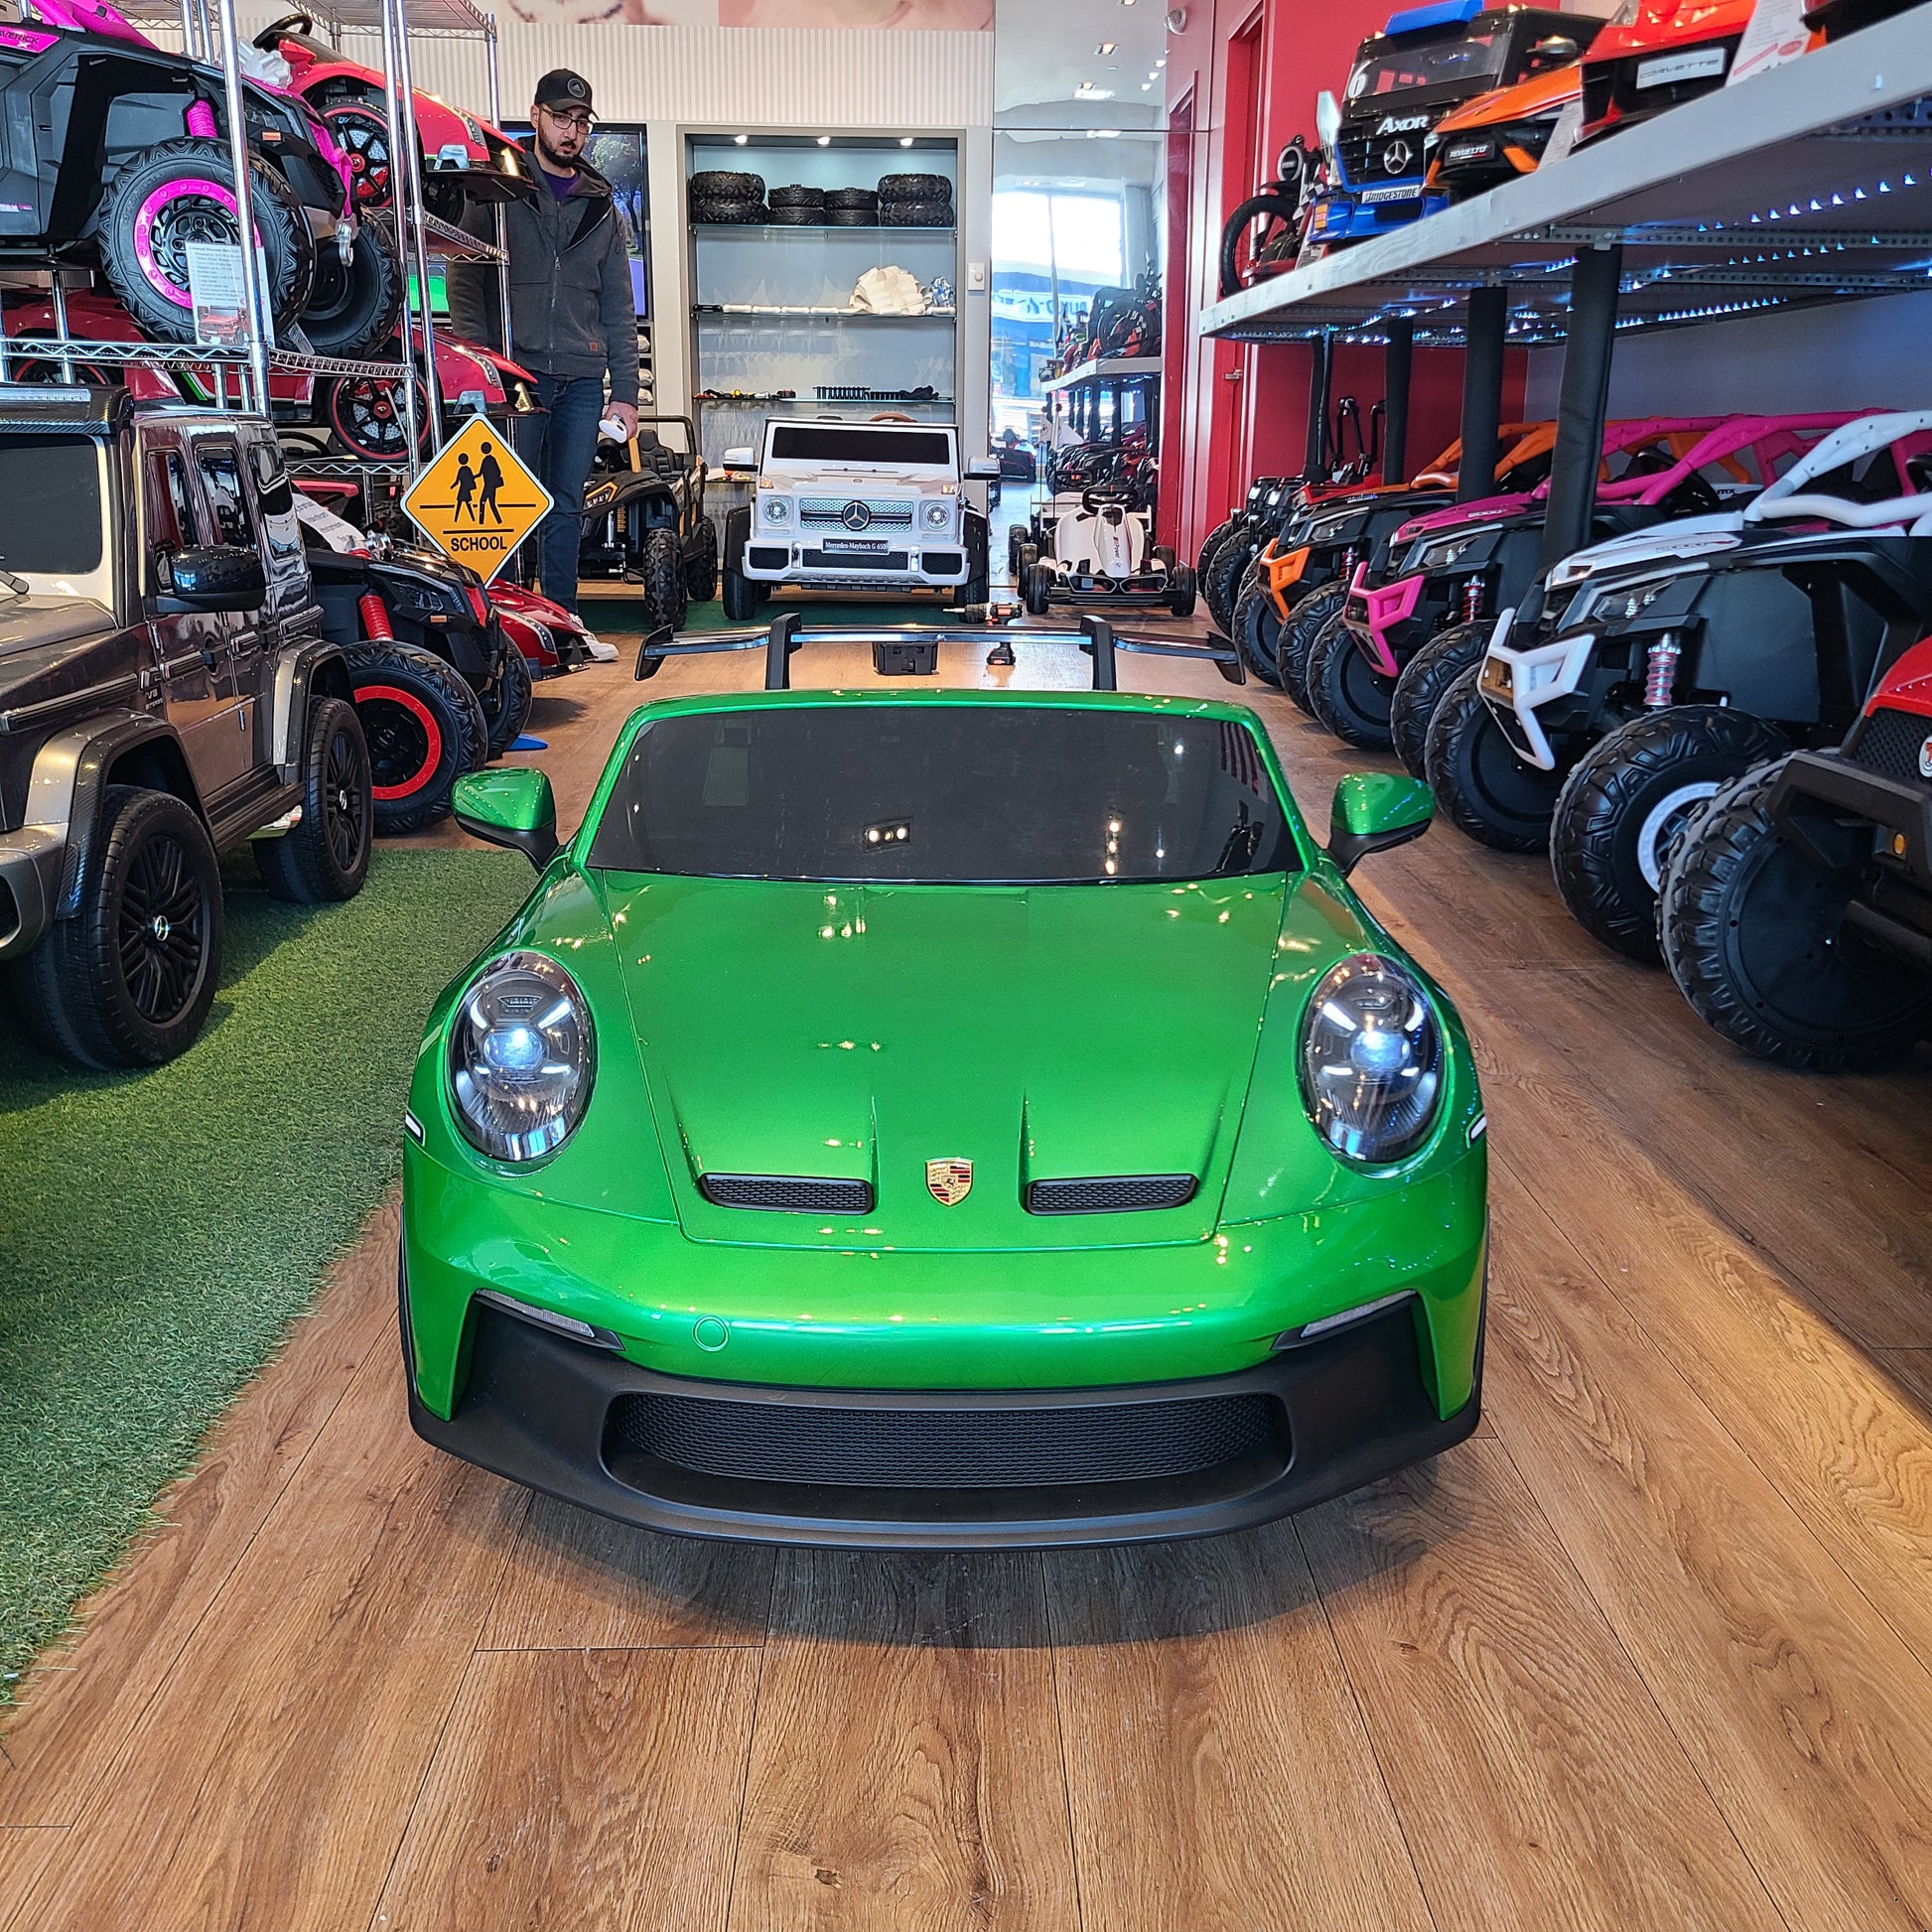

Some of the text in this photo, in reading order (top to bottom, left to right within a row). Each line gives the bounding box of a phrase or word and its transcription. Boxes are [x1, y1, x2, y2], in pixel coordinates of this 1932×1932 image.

[1639, 59, 1720, 78] CORVETTE
[1347, 60, 1371, 98] 6
[1364, 188, 1418, 203] BRIDGESTONE
[451, 536, 507, 552] SCHOOL
